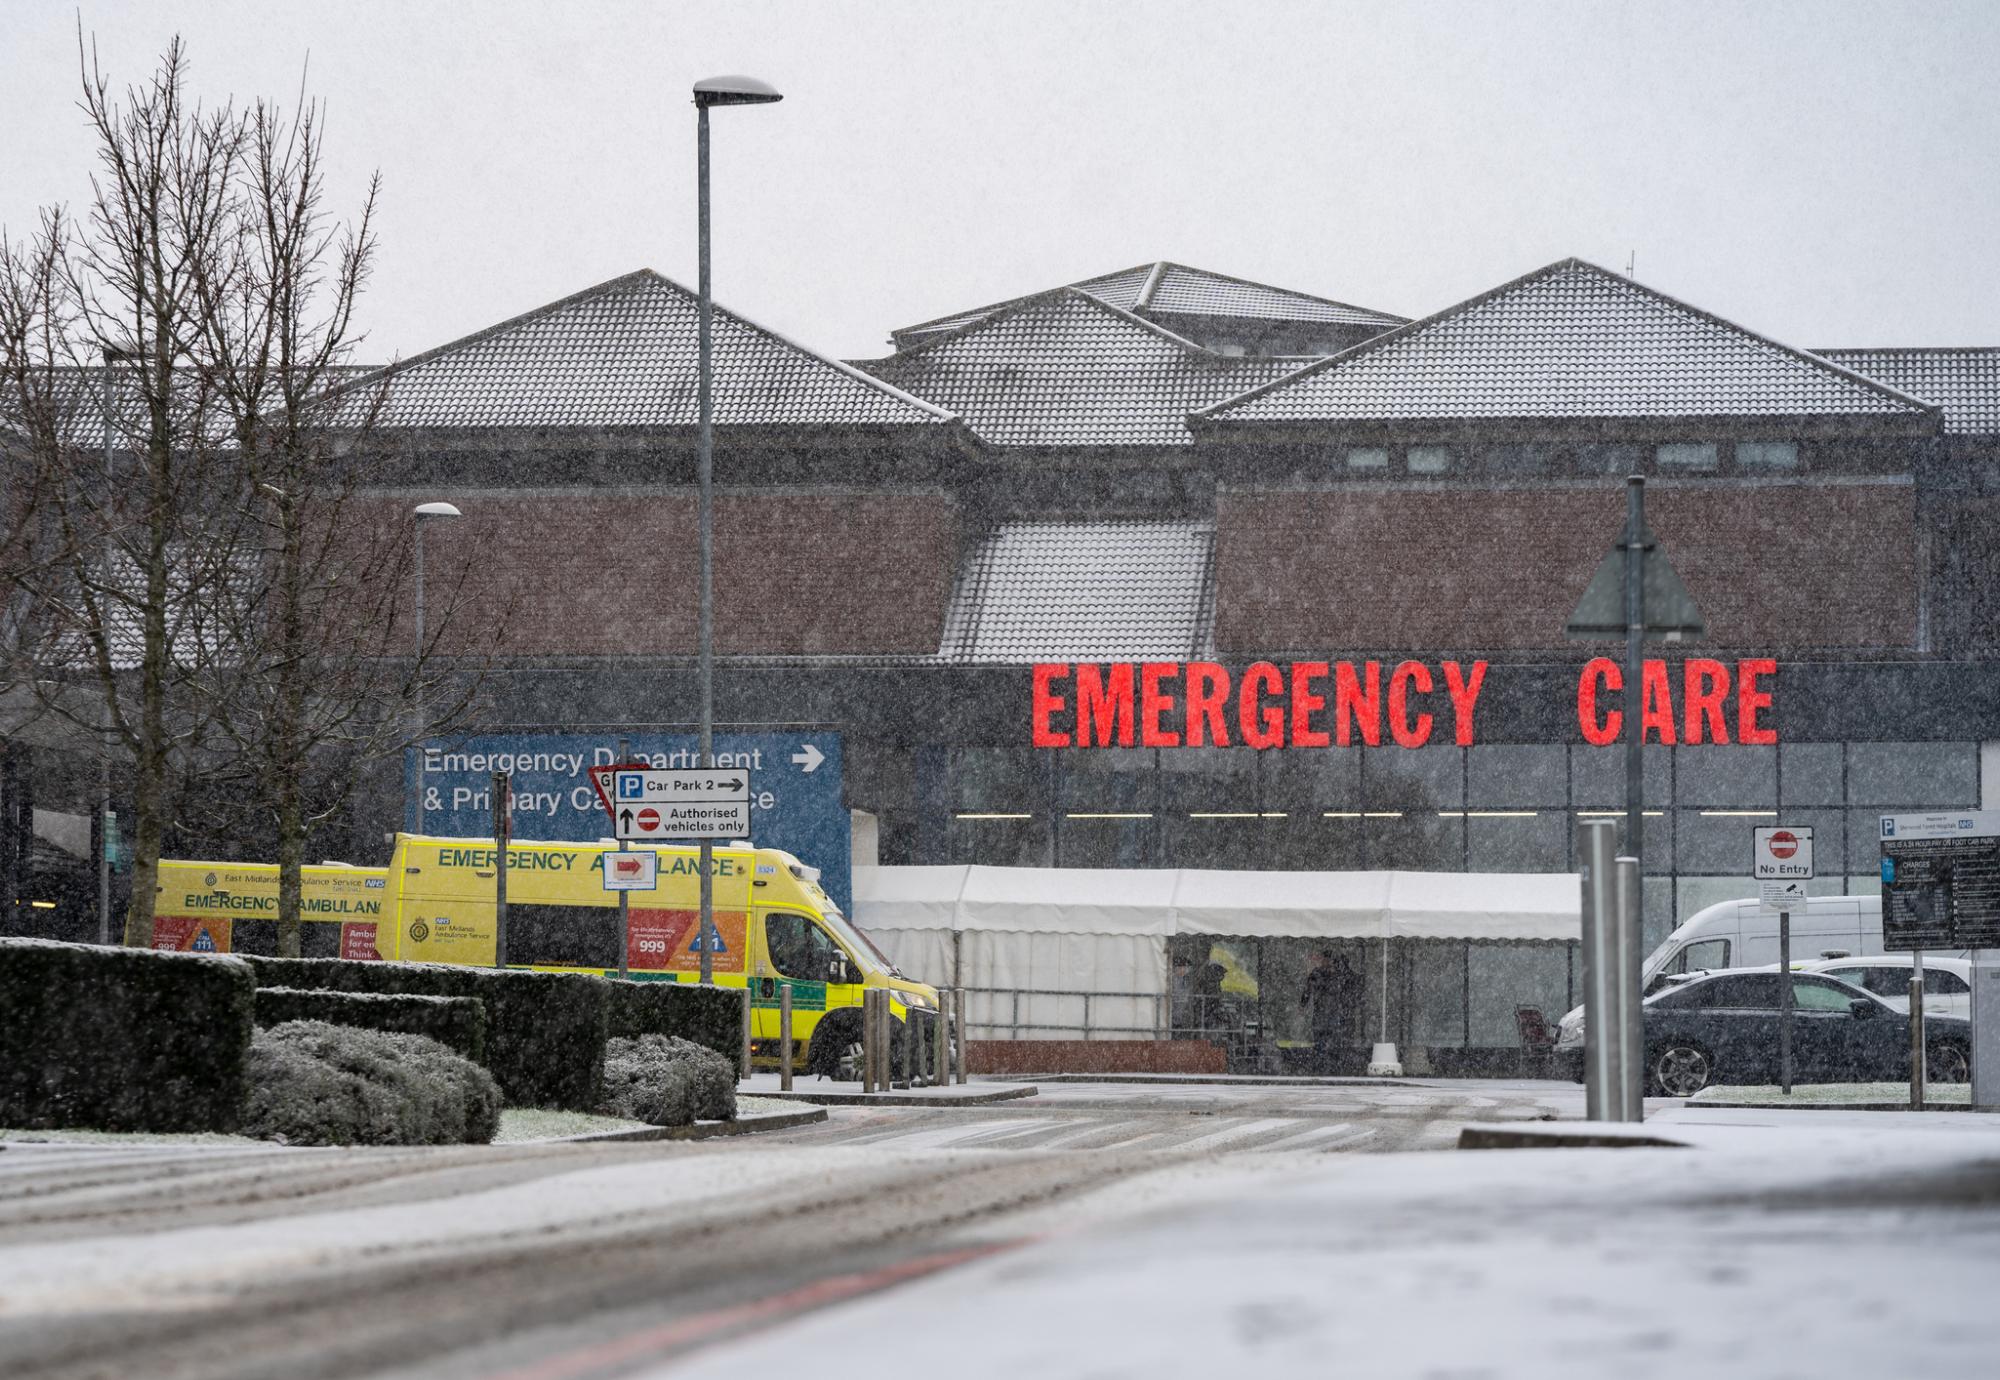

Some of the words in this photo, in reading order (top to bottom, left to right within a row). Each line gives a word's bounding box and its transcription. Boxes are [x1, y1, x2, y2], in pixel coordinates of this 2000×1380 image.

[1031, 659, 1489, 749] EMERGENCY
[1577, 656, 1778, 747] CARE
[424, 748, 584, 778] Emergency
[593, 747, 763, 771] Dartment
[624, 777, 640, 797] P
[646, 781, 668, 792] Car
[674, 780, 702, 792] Park
[706, 780, 714, 790] 2
[424, 786, 444, 811] &
[453, 786, 562, 817] Priary
[670, 808, 738, 819] Authorised
[664, 822, 714, 832] vehicles
[718, 821, 745, 833] only
[1883, 819, 1893, 835] P
[438, 848, 578, 871] EMERGENCY
[590, 854, 734, 877] ALANE
[1760, 865, 1776, 874] No
[1780, 865, 1809, 875] Entry
[225, 873, 242, 882] East
[366, 879, 385, 888] NHS
[297, 898, 381, 914] AMBULAN
[639, 940, 666, 953] 999
[695, 937, 720, 951] 11
